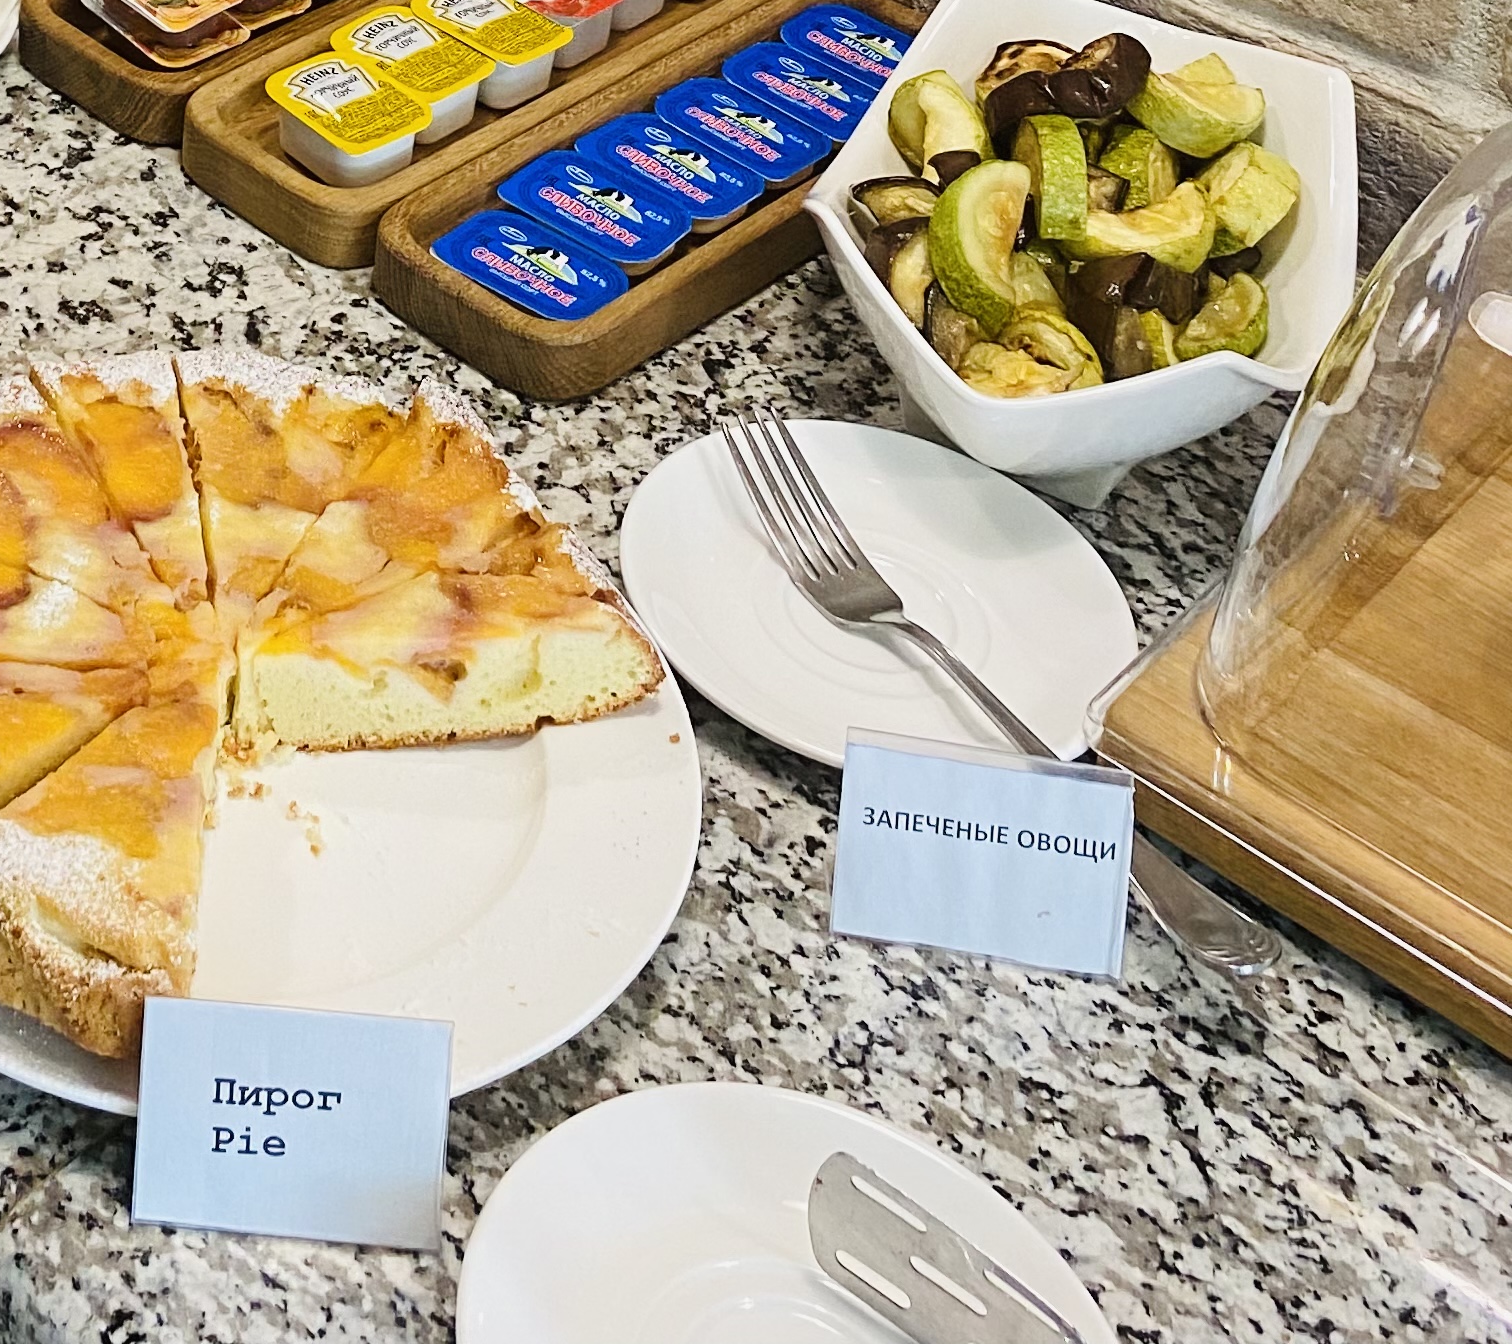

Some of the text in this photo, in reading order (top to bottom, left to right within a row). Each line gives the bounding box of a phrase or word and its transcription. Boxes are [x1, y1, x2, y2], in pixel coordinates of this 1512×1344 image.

[363, 19, 399, 40] HEINZ
[806, 29, 895, 79] СЛИВОЧНО
[841, 37, 883, 62] МАСЛО
[299, 67, 340, 87] HEINZ
[788, 76, 830, 101] МАСЛО
[751, 70, 849, 122] СЛИВОЧНОЕ
[684, 106, 783, 163] СЛИВОЧНОЕ
[721, 115, 764, 141] МАСЛО
[615, 144, 714, 204] СЛИВОЧНОЕ
[652, 152, 695, 180] МАСЛО
[538, 186, 642, 248] СЛИВОЧНОЕ
[575, 193, 621, 221] МАСЛО
[471, 246, 578, 308] СЛИВОЧНОЕ
[509, 254, 556, 284] МАСЛО
[862, 806, 1117, 864] ЗАПЕЧЕНЫЕ ОВОЩИ
[212, 1077, 342, 1115] Пирог
[211, 1125, 287, 1157] Pie
